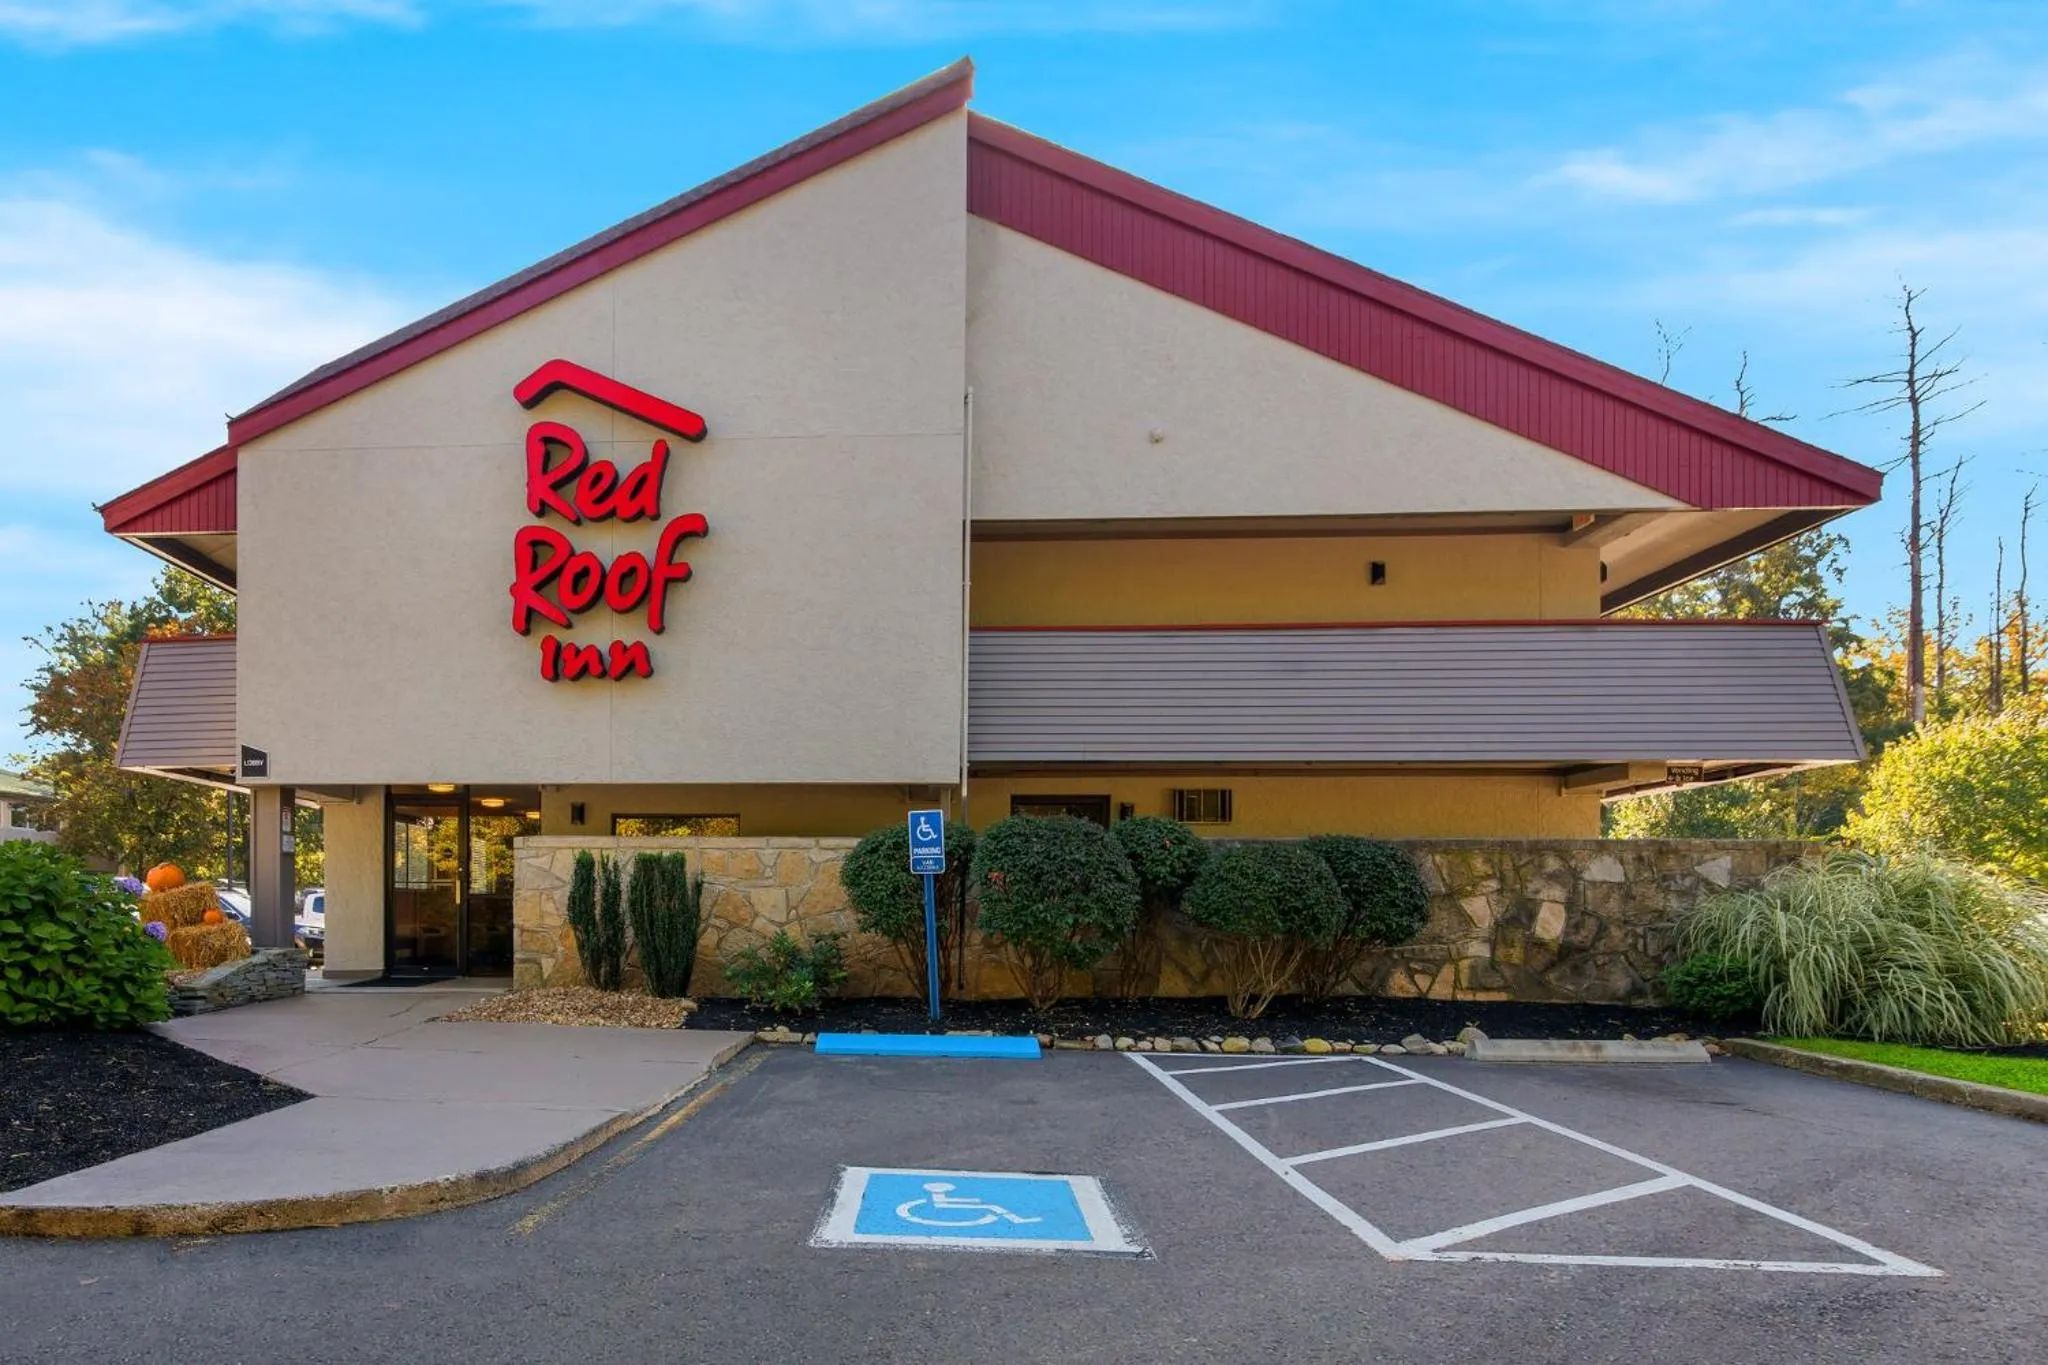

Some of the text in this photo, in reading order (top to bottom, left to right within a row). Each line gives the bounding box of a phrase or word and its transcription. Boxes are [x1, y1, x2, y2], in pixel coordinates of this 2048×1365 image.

[525, 420, 670, 526] Red
[509, 512, 708, 636] Roof
[540, 634, 654, 682] Inn
[243, 759, 264, 767] LOBBY
[913, 847, 941, 855] PARKING
